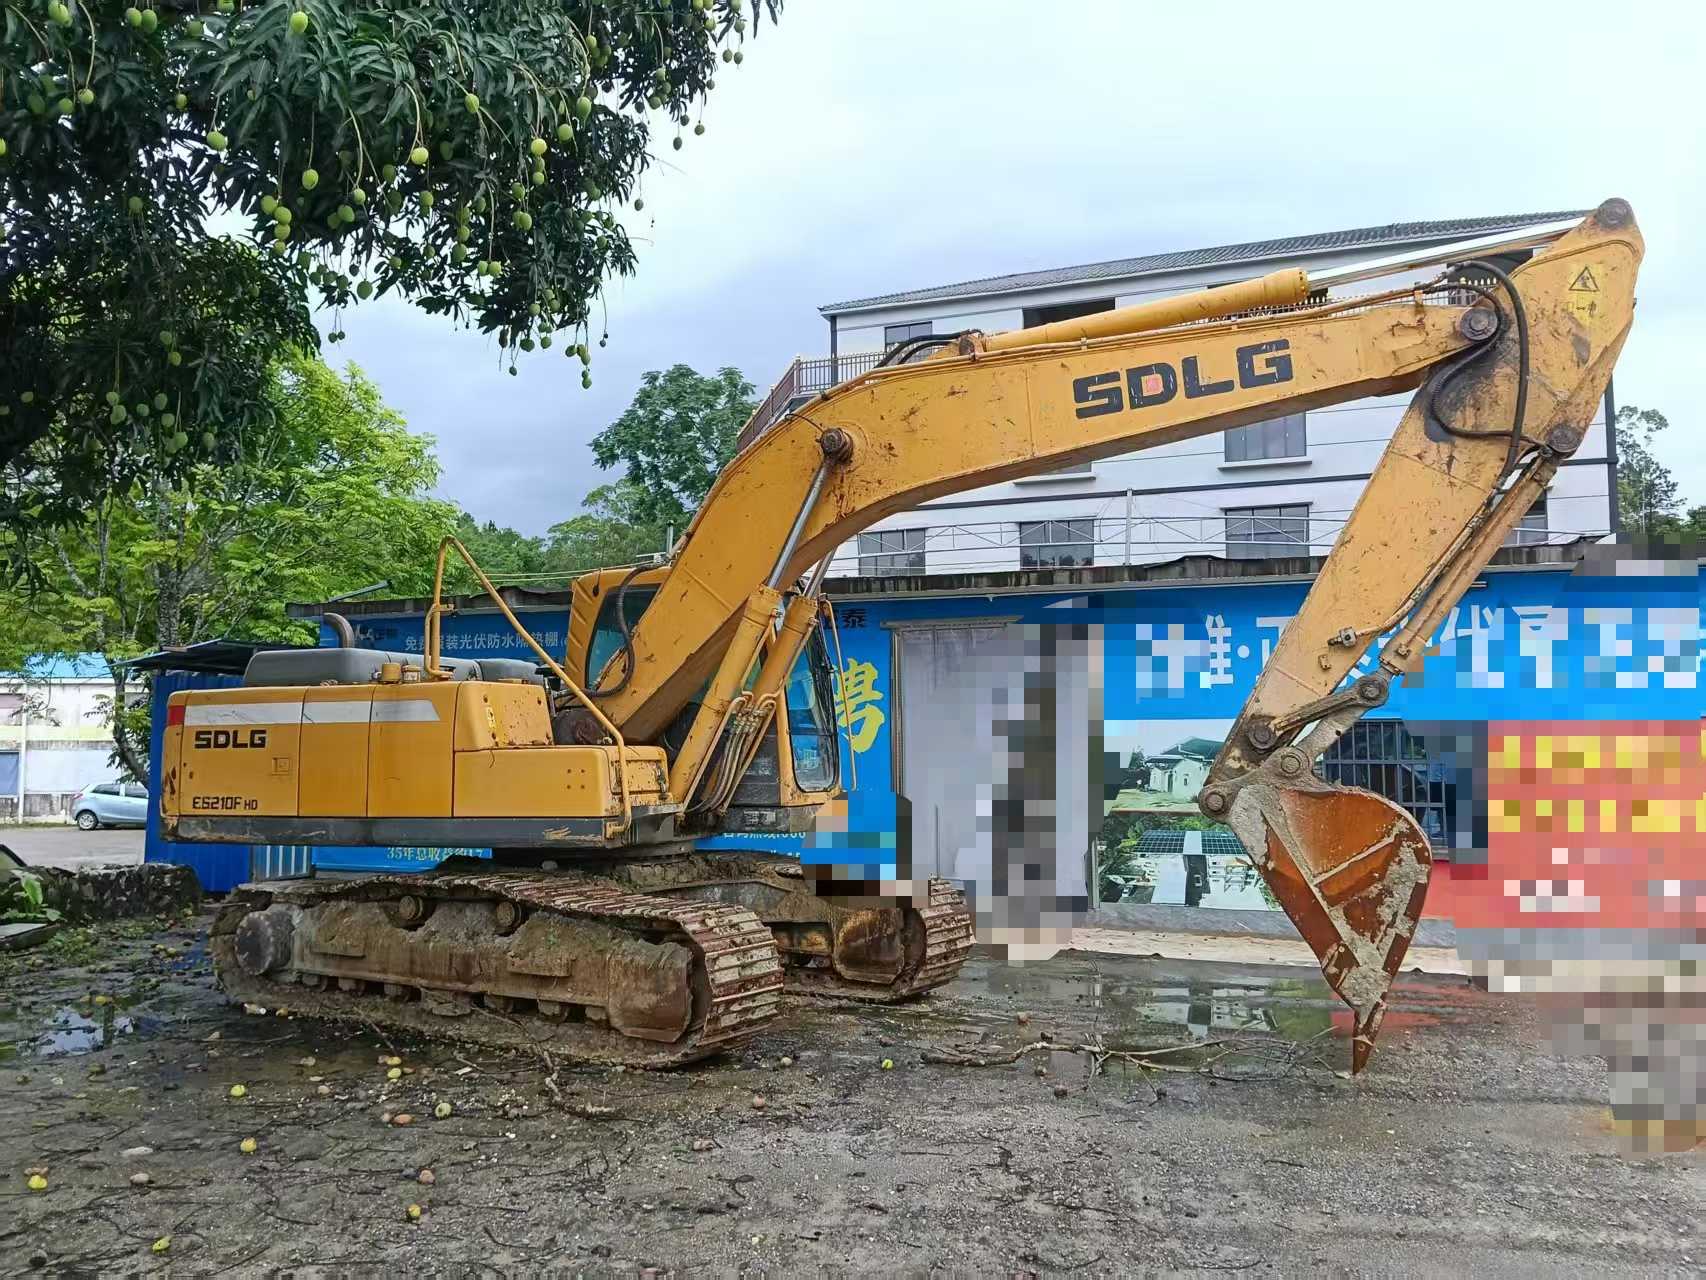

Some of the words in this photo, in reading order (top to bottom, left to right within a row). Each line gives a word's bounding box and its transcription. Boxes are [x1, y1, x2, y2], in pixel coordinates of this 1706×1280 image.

[1073, 338, 1294, 419] SDLG
[194, 729, 267, 749] SDLG
[192, 796, 242, 810] E6210F
[244, 799, 258, 810] HD
